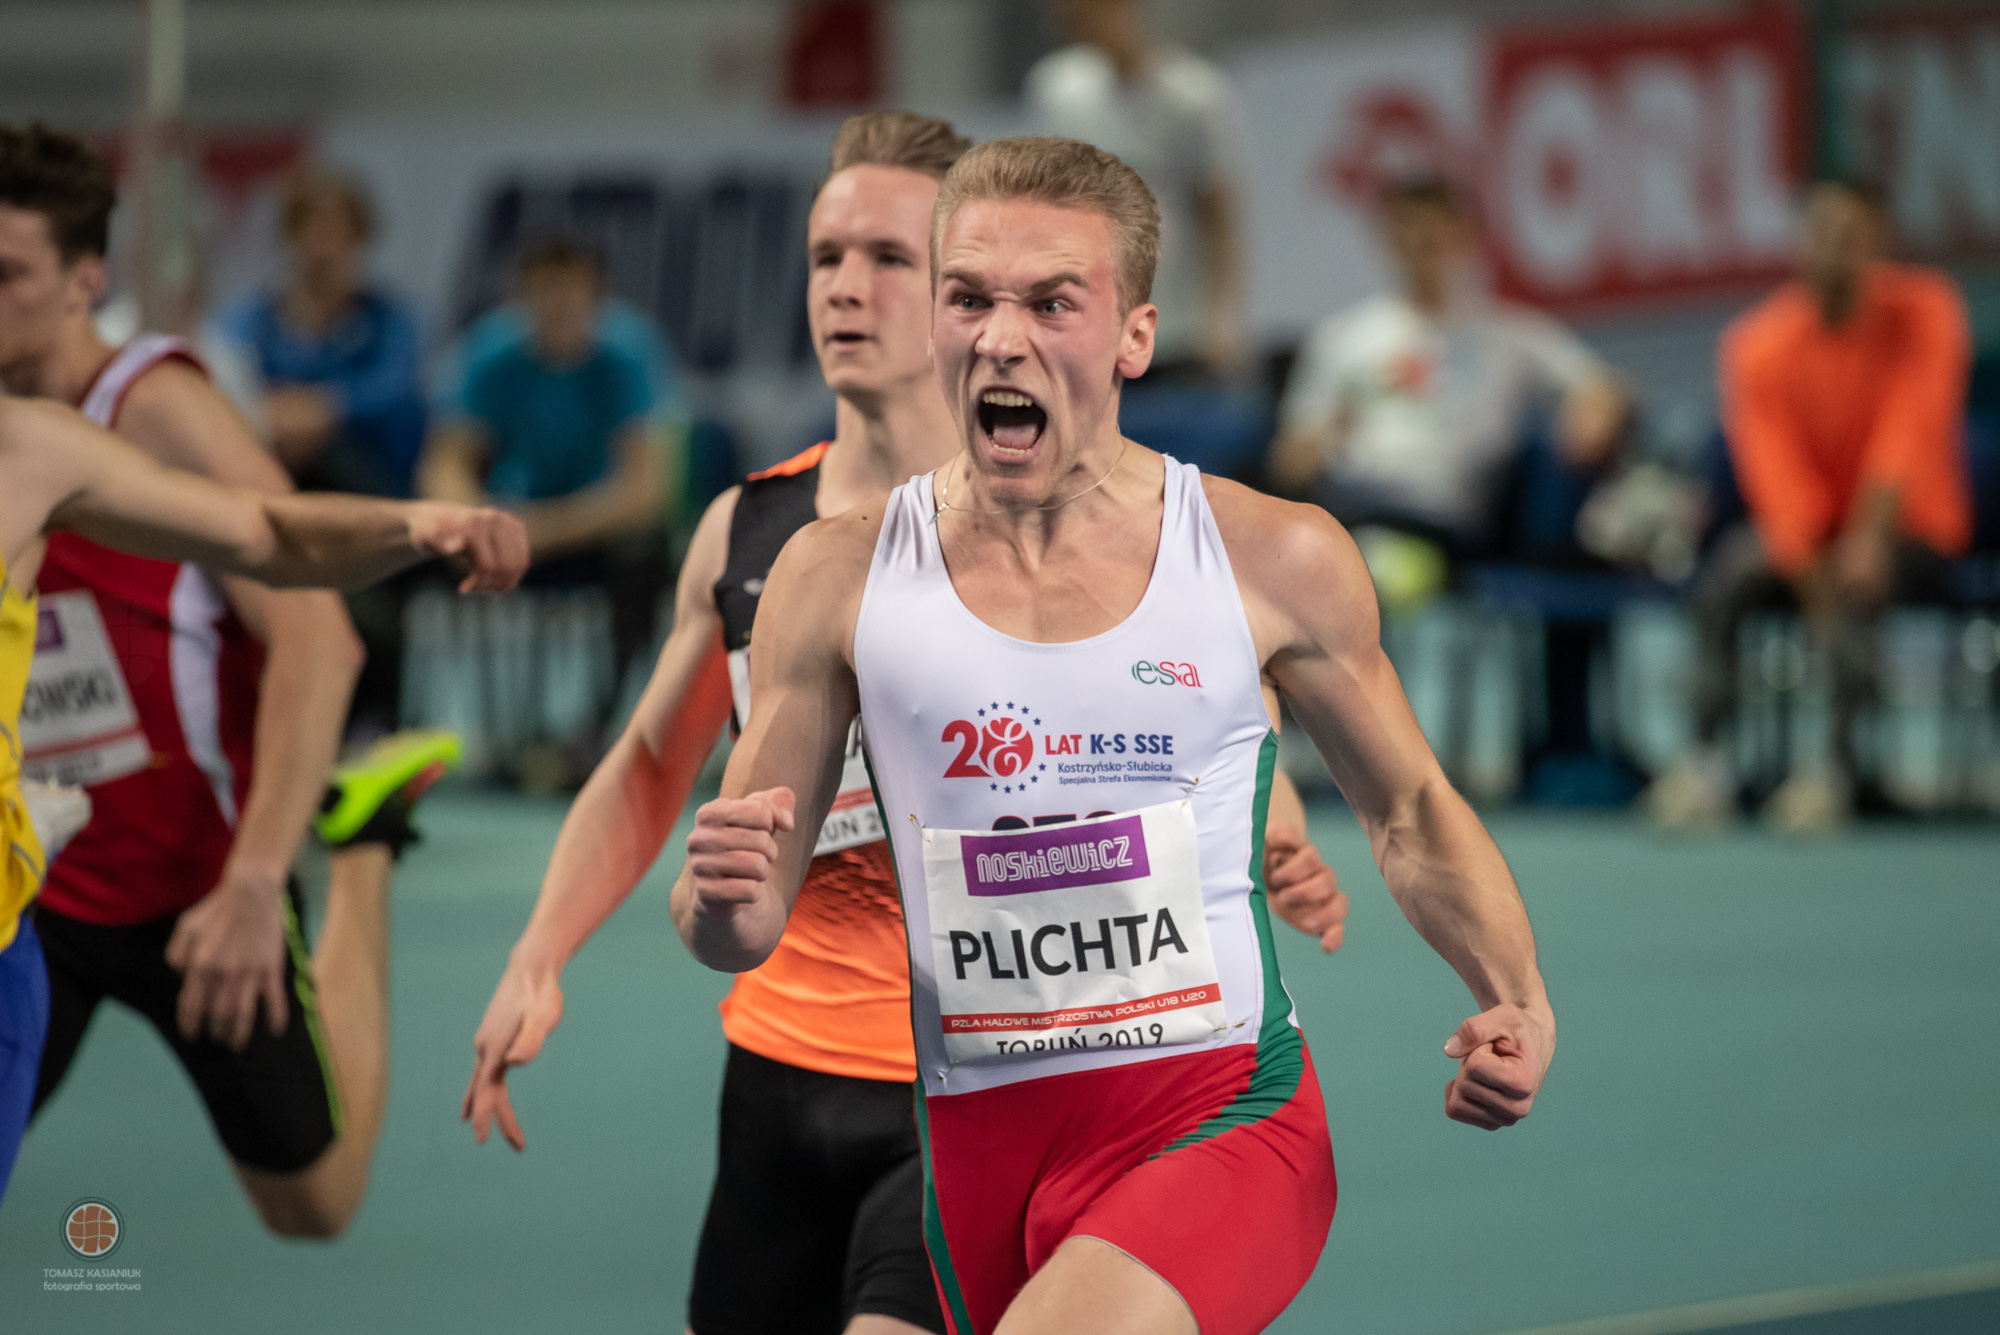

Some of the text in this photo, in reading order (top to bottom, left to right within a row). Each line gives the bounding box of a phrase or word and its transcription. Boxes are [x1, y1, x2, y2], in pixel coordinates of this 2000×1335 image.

[1045, 733, 1174, 755] LAT K-S SSE
[1058, 761, 1173, 774] Kostrzyńsko-Słubicka
[1058, 774, 1171, 786] Specjalna Strefa Ekonomiczna
[949, 907, 1189, 980] PLICHTA
[951, 991, 1207, 1028] PZLA HALOWE MISTRZOSTWA POLSKI U18 U20
[1098, 1023, 1164, 1047] 2019
